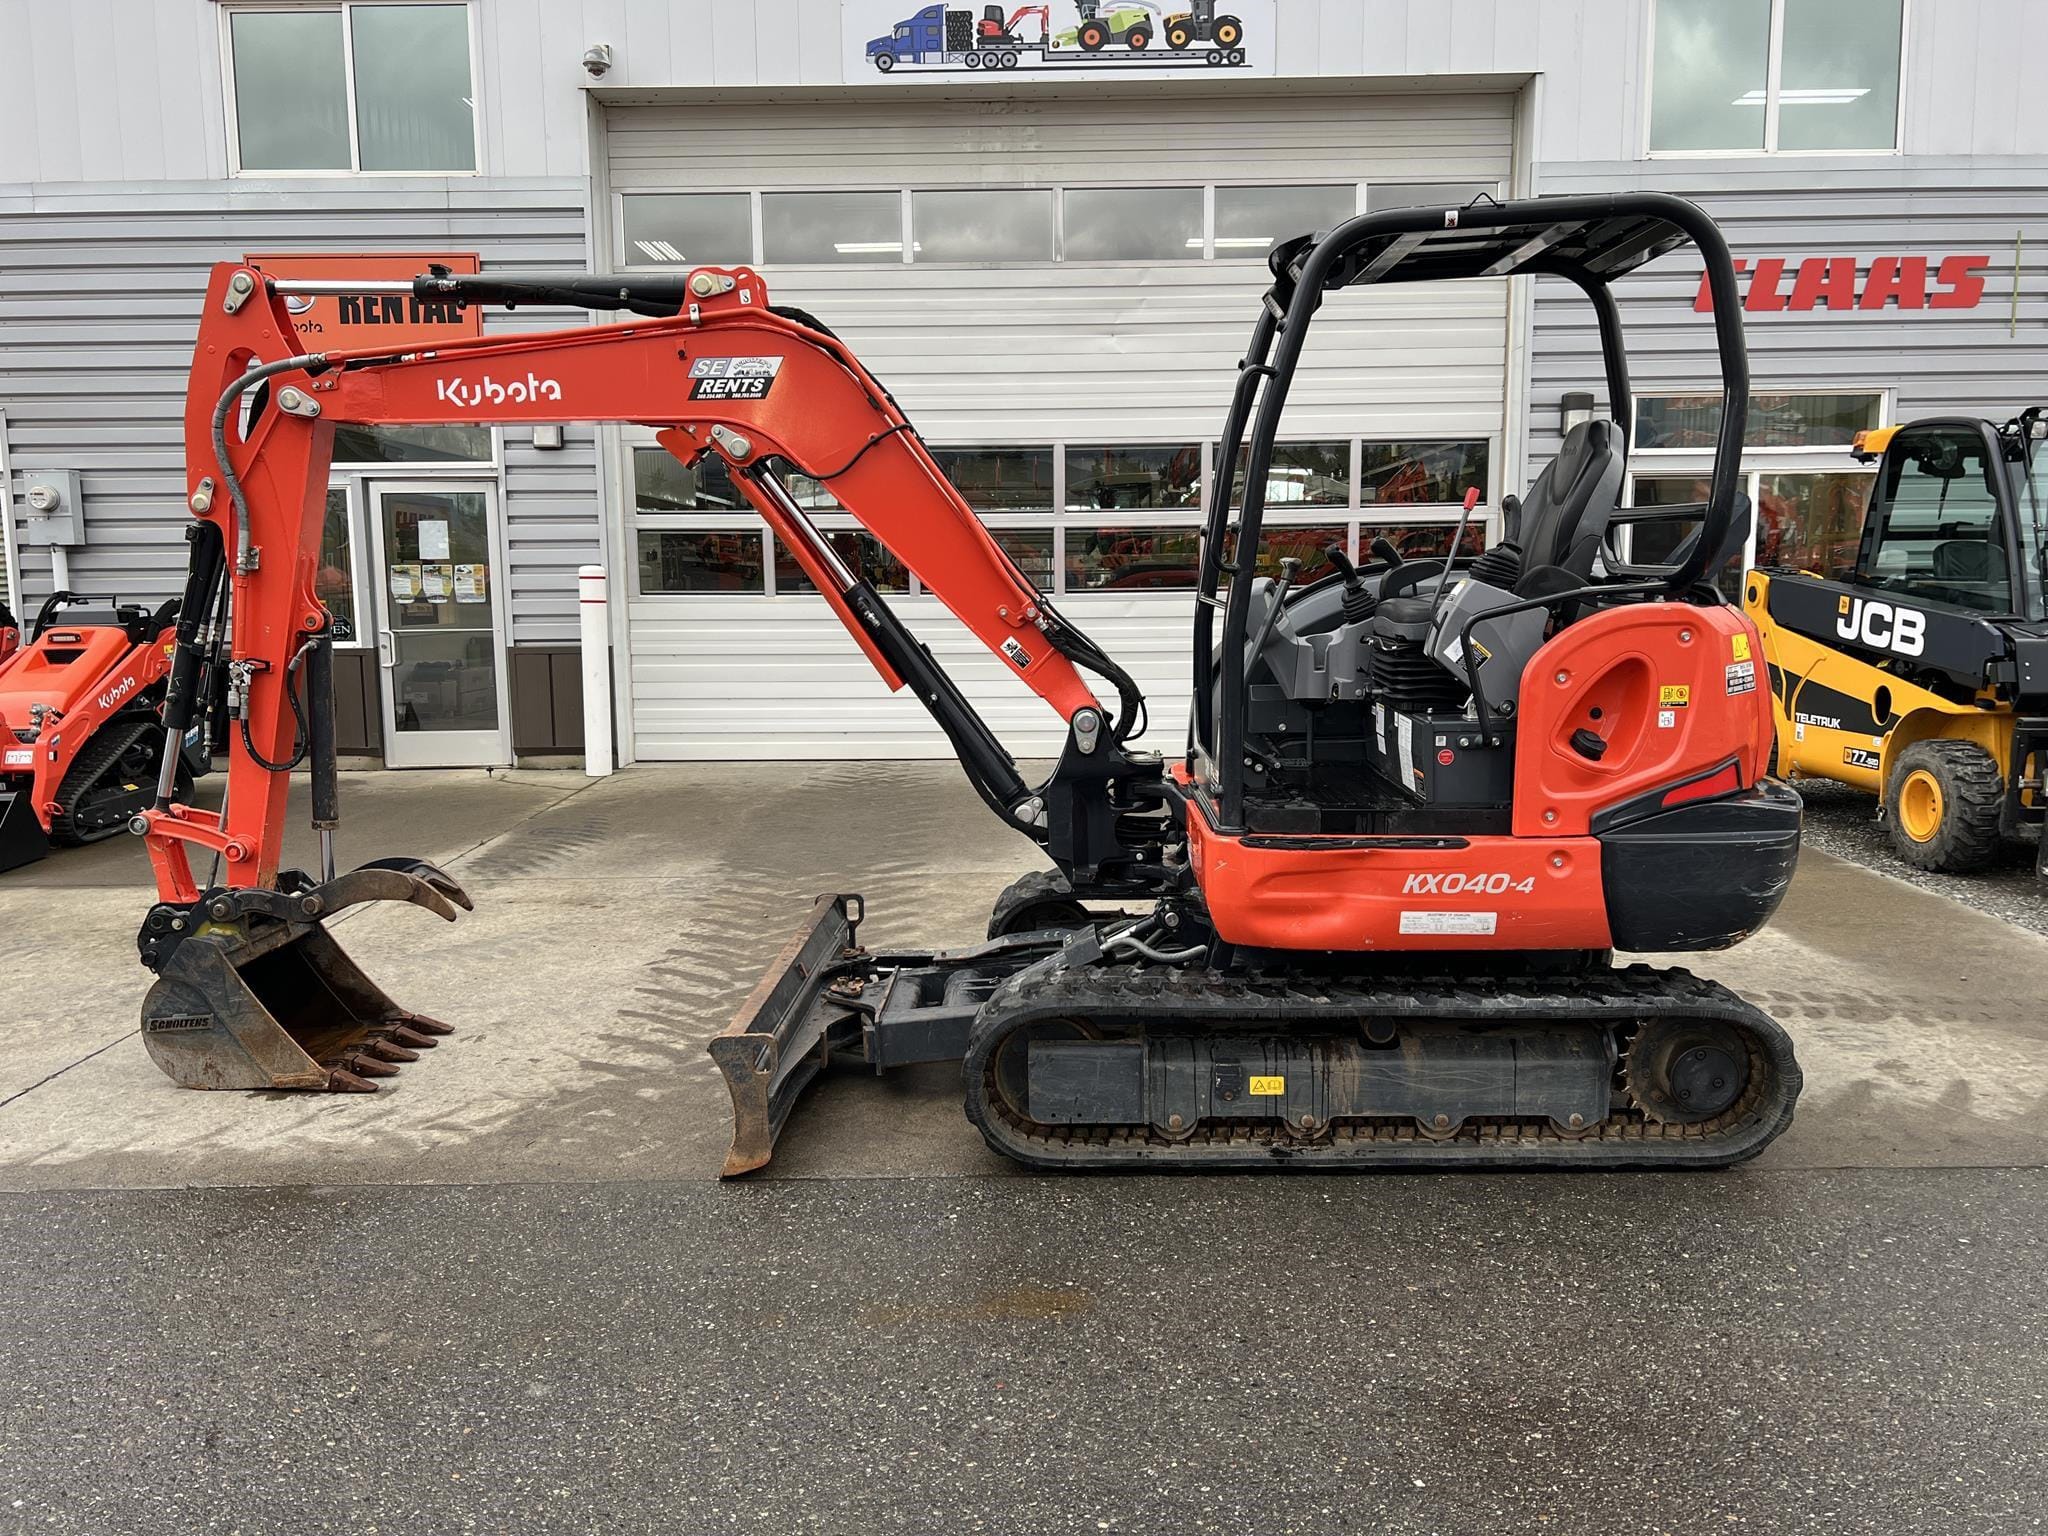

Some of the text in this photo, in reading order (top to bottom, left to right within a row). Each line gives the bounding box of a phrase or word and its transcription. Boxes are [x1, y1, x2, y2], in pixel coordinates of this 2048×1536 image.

[293, 319, 323, 333] ota
[694, 359, 727, 376] SE
[436, 372, 562, 407] Kubota
[698, 378, 765, 393] RENTS
[331, 625, 351, 635] EN
[1836, 598, 1926, 657] JCB
[97, 676, 136, 710] Kubota
[1795, 712, 1841, 729] TELETRUK
[1402, 873, 1536, 894] KX040-4
